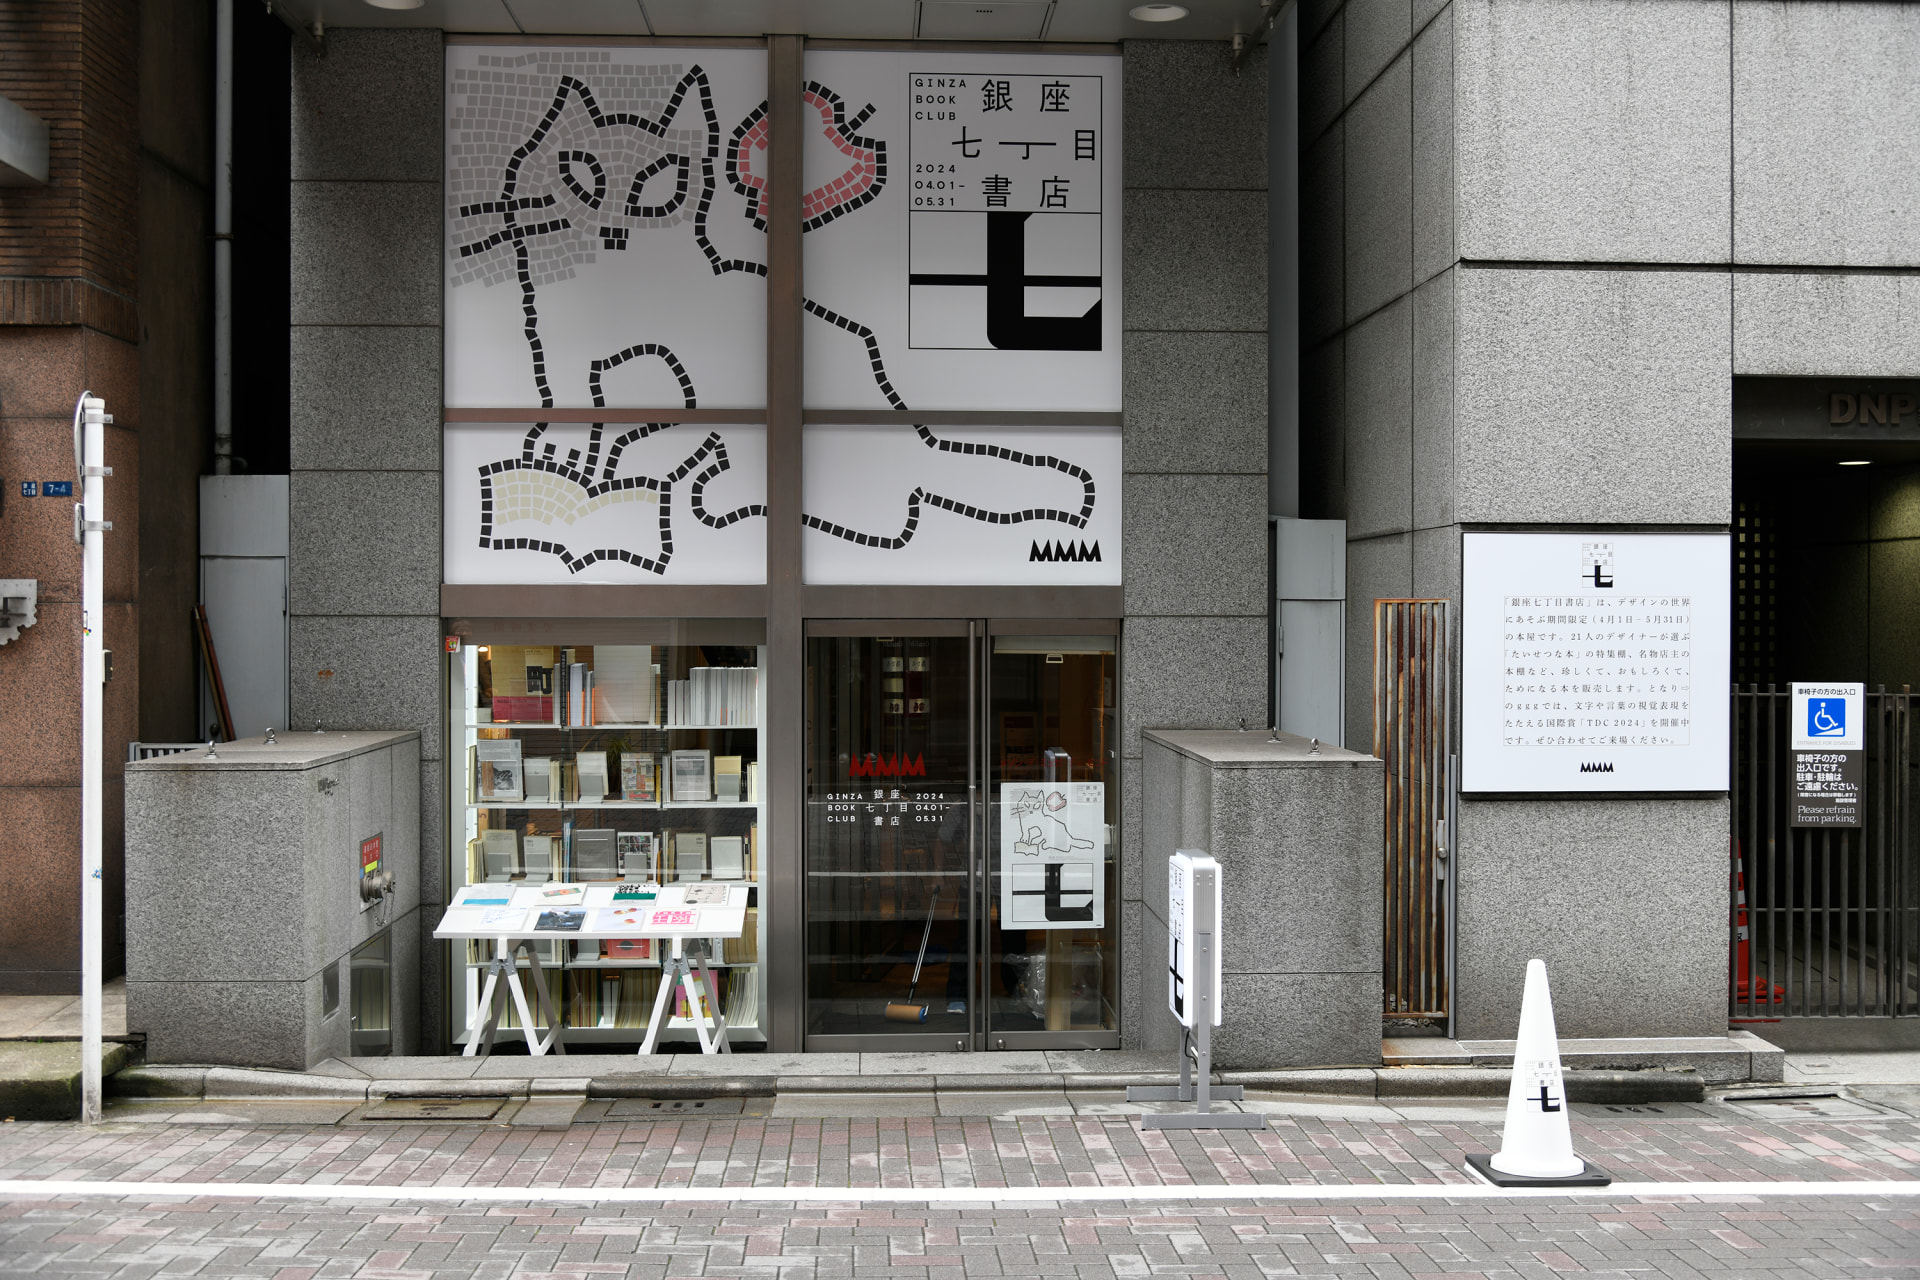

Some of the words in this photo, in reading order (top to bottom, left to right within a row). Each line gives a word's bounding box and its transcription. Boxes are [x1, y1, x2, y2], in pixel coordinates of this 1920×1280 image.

[915, 78, 967, 88] GINZA
[915, 94, 956, 105] BOOK
[981, 79, 1071, 113] 銀座
[914, 111, 956, 121] CLUB
[951, 126, 1096, 161] 七丁目
[915, 163, 956, 174] 2024
[981, 174, 1071, 209] 書店
[914, 196, 954, 207] 05.31
[1830, 393, 1915, 425] DNP
[1028, 539, 1102, 562] MMM
[1798, 688, 1856, 696] 車椅子の方の出入口
[1796, 753, 1847, 763] 車椅子の方の
[848, 752, 927, 777] MMM
[1580, 761, 1614, 773] MMM
[1796, 764, 1842, 772] 出入口です。
[1796, 782, 1859, 791] ご遠慮ください。
[873, 788, 900, 800] 銀座
[916, 792, 944, 800] 2024
[865, 803, 908, 813] 七丁目
[1797, 805, 1825, 814] Please
[1826, 805, 1856, 814] refrain
[827, 815, 856, 823] CLUB
[873, 815, 900, 826] 書店
[1797, 813, 1819, 822] from
[1821, 814, 1857, 824] parking.
